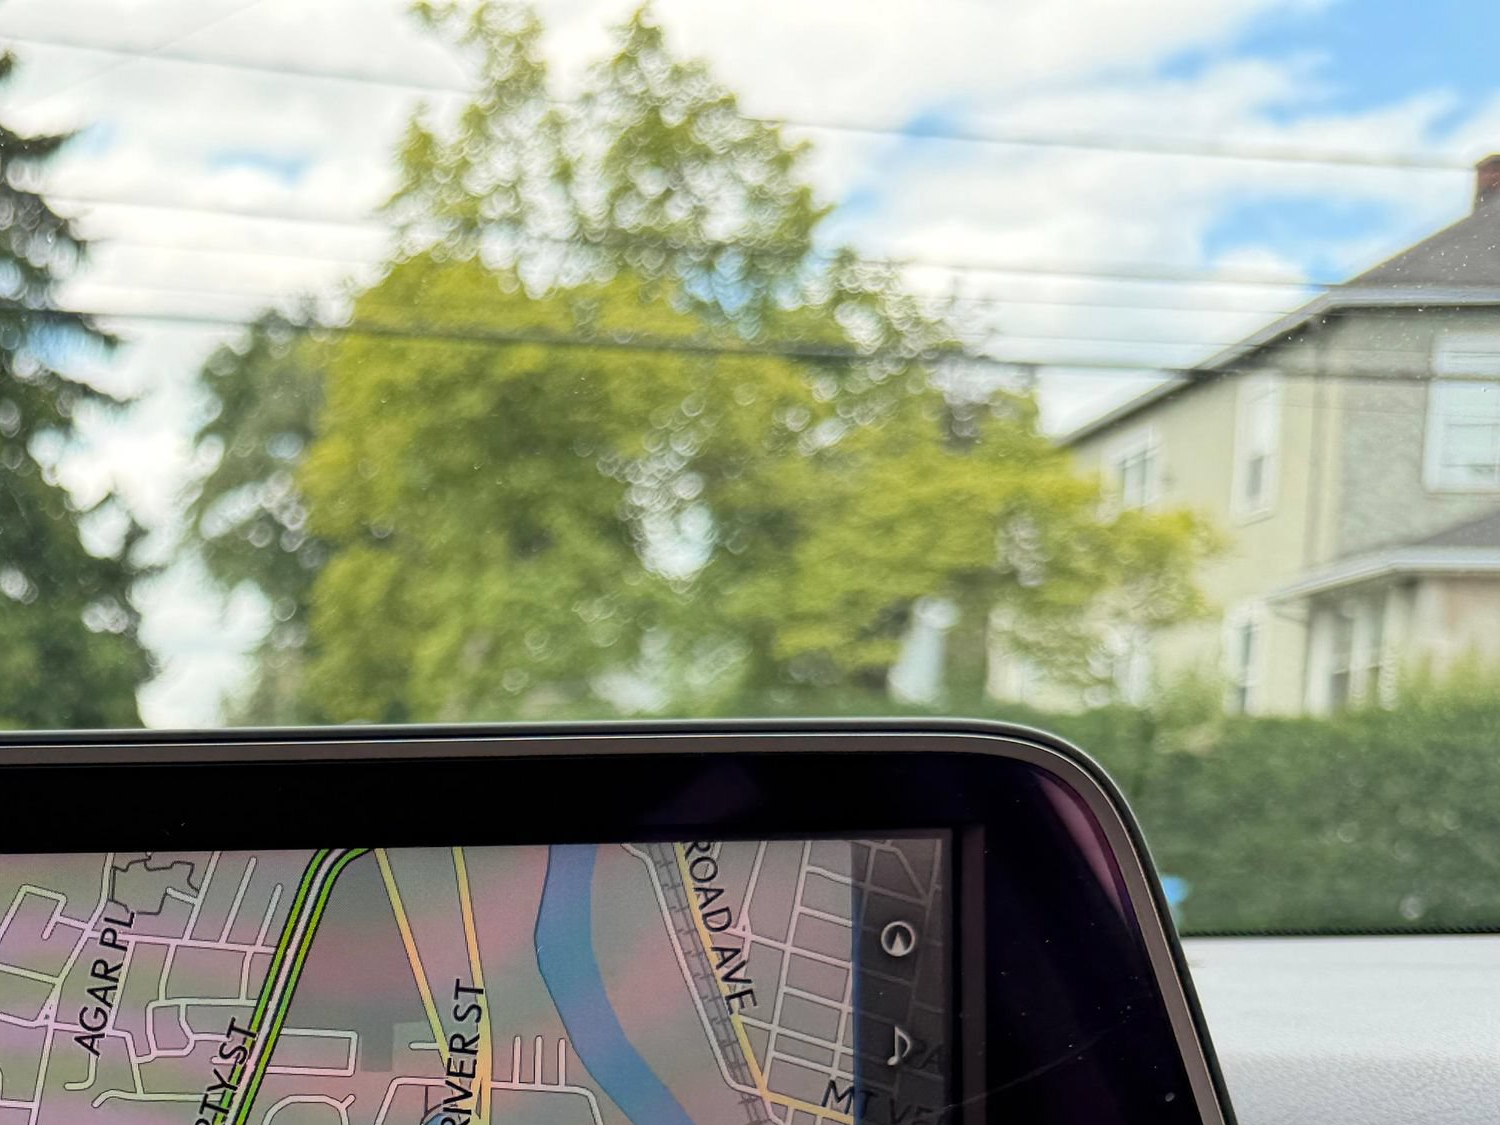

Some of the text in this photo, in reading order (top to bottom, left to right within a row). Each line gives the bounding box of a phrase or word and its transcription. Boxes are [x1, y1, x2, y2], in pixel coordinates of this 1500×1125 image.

[75, 909, 135, 1057] AGAR PL
[454, 977, 485, 1025] ST
[710, 946, 758, 1016] AVE
[219, 1016, 259, 1066] ST
